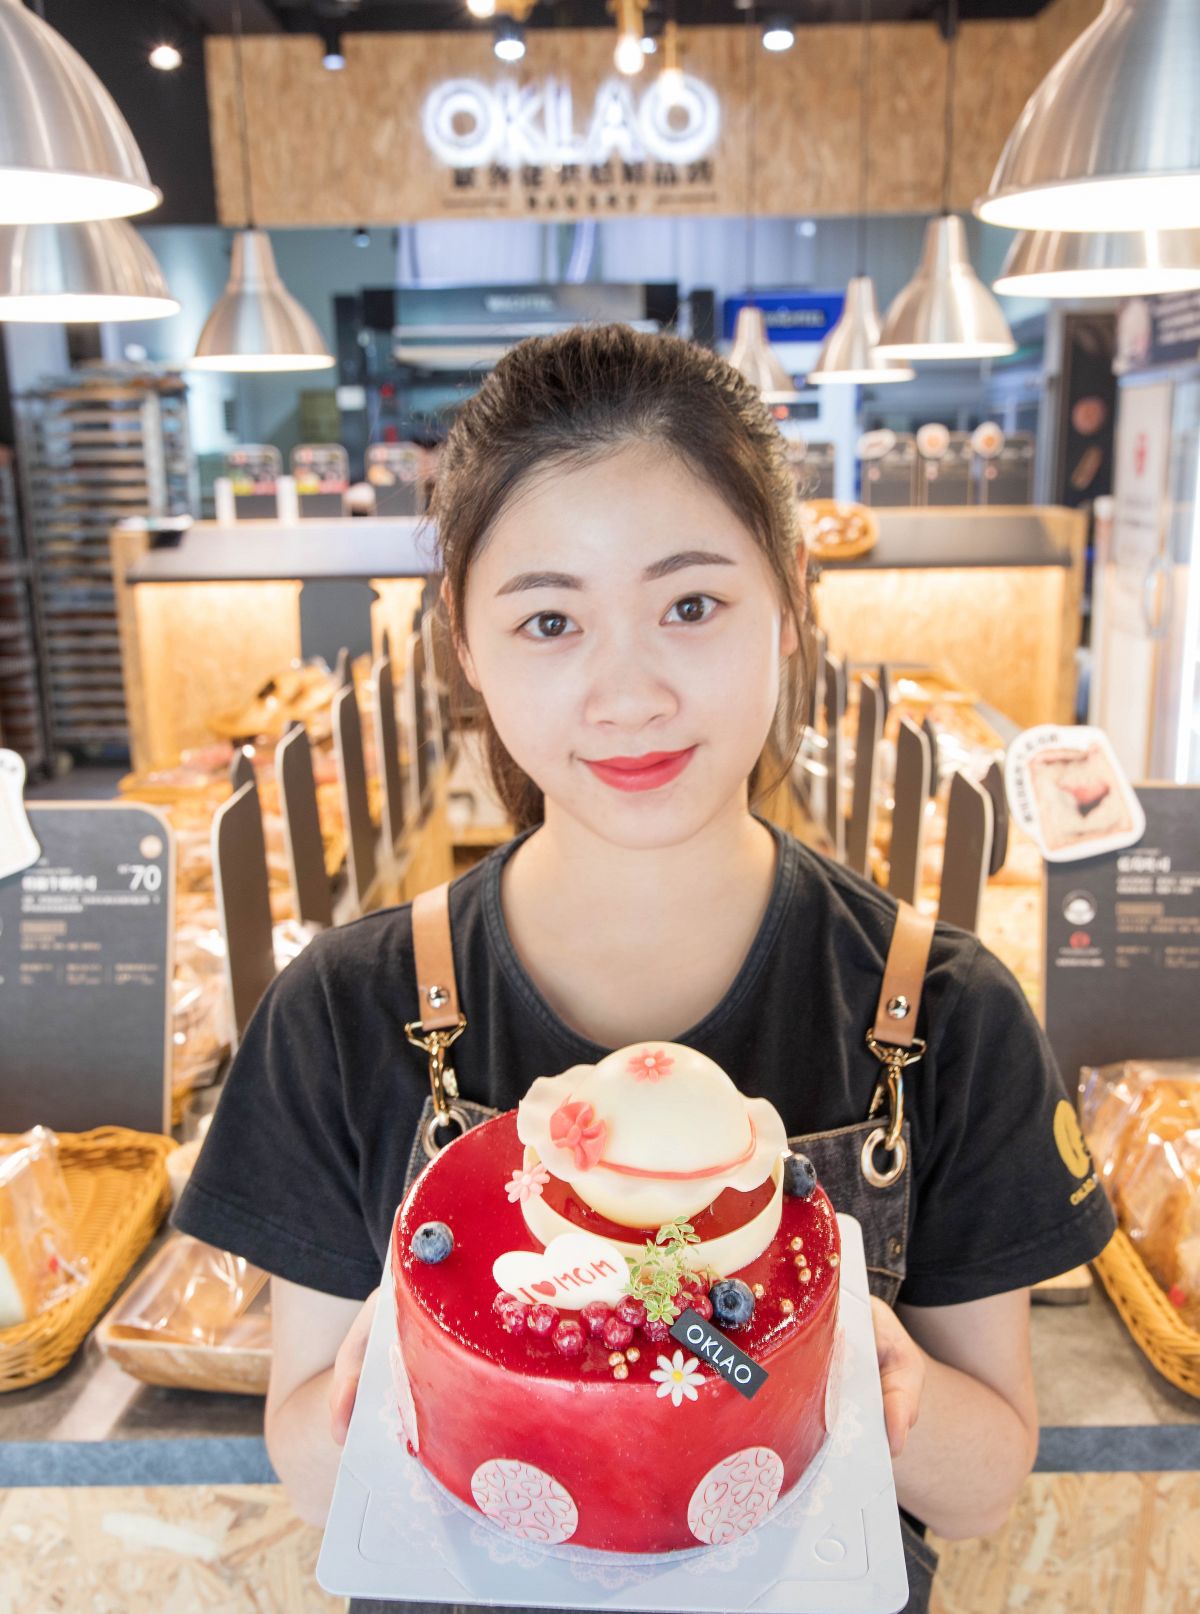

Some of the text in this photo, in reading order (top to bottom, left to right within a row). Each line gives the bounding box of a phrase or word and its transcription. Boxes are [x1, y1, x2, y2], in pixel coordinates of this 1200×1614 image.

[425, 80, 717, 165] OKLAO
[129, 864, 162, 892] 70
[553, 1260, 617, 1291] MOM
[686, 1324, 752, 1384] OKLAO
